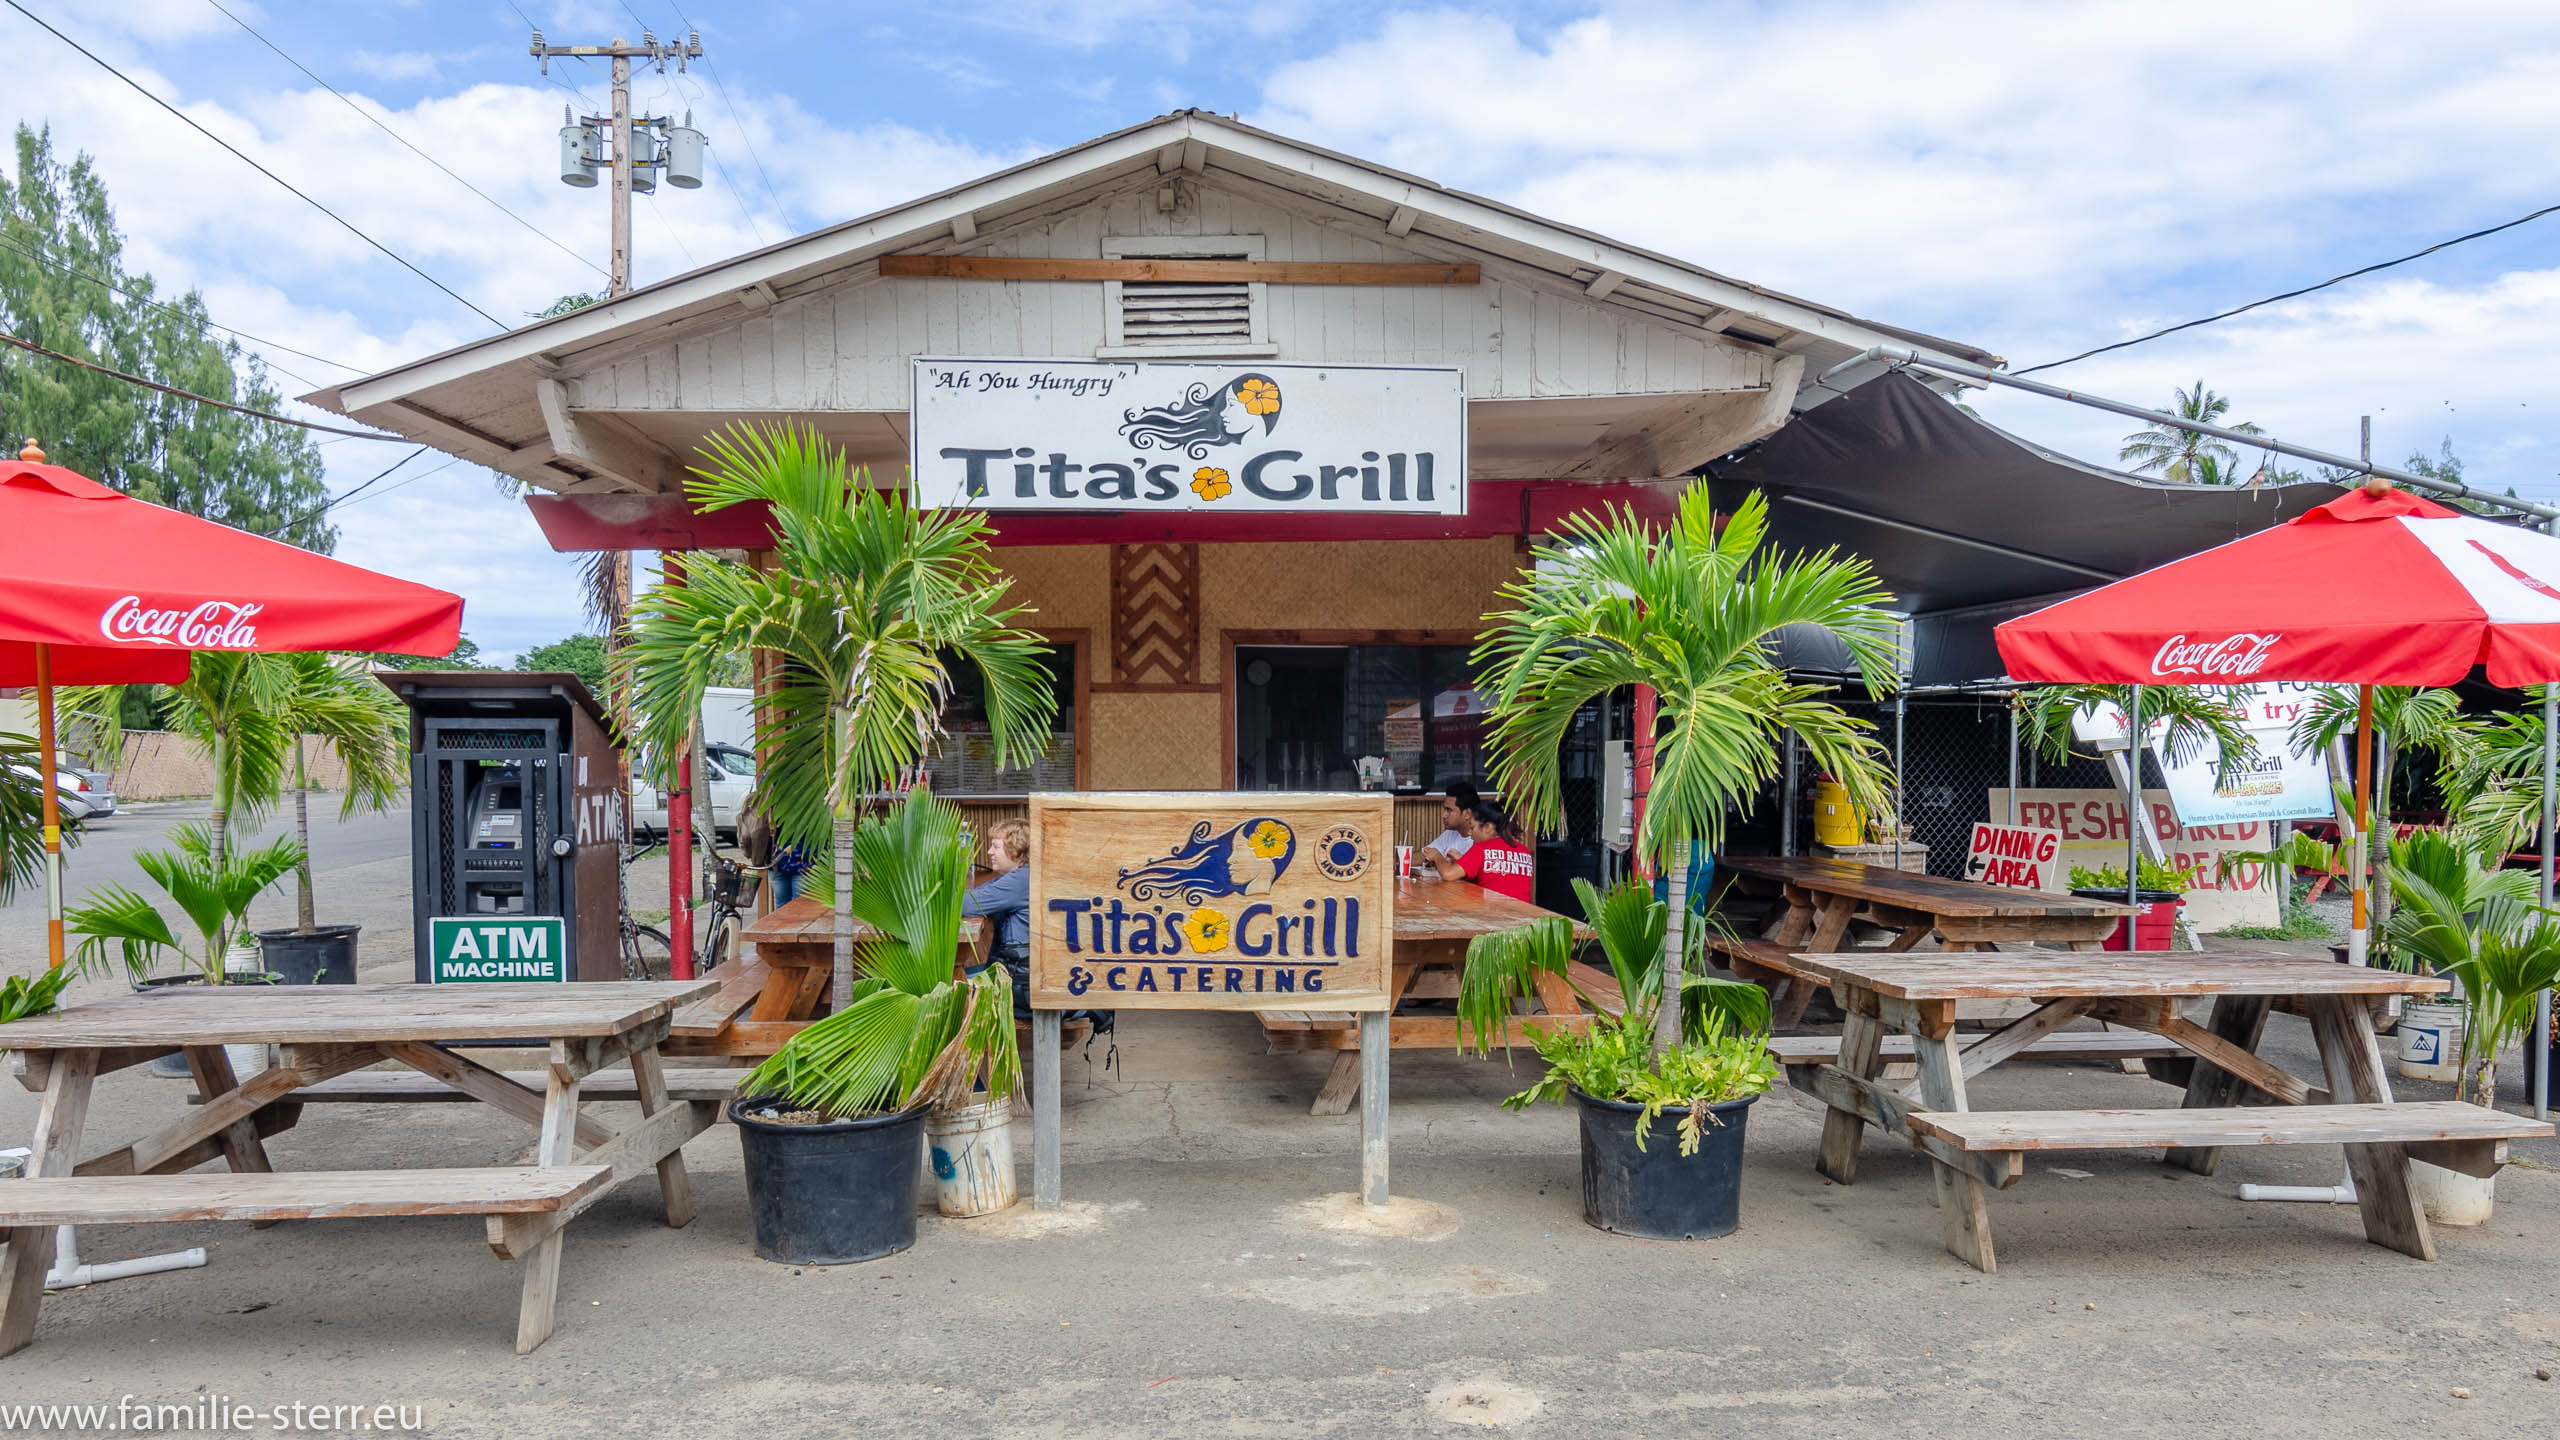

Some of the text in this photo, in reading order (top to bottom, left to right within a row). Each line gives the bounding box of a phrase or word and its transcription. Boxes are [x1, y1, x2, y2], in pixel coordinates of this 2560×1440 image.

[978, 372, 1020, 393] You
[939, 447, 1436, 501] Tita's Grill
[100, 595, 264, 647] Coca-Cola
[2151, 633, 2283, 676] Coca-Cola
[2263, 702, 2300, 721] try
[2251, 755, 2283, 773] Grill
[577, 794, 617, 844] ATM
[2020, 801, 2129, 840] FRESH
[1320, 830, 1362, 850] AH YOU
[1484, 849, 1504, 860] RED
[1973, 826, 2057, 862] DINING
[1320, 855, 1366, 877] HUNGRY
[1982, 857, 2040, 889] AREA
[2165, 852, 2259, 891] READ
[1048, 896, 1359, 957] Tita's Grill
[449, 927, 548, 959] ATM
[442, 962, 555, 977] MACHINE
[1068, 966, 1323, 996] & CATERING
